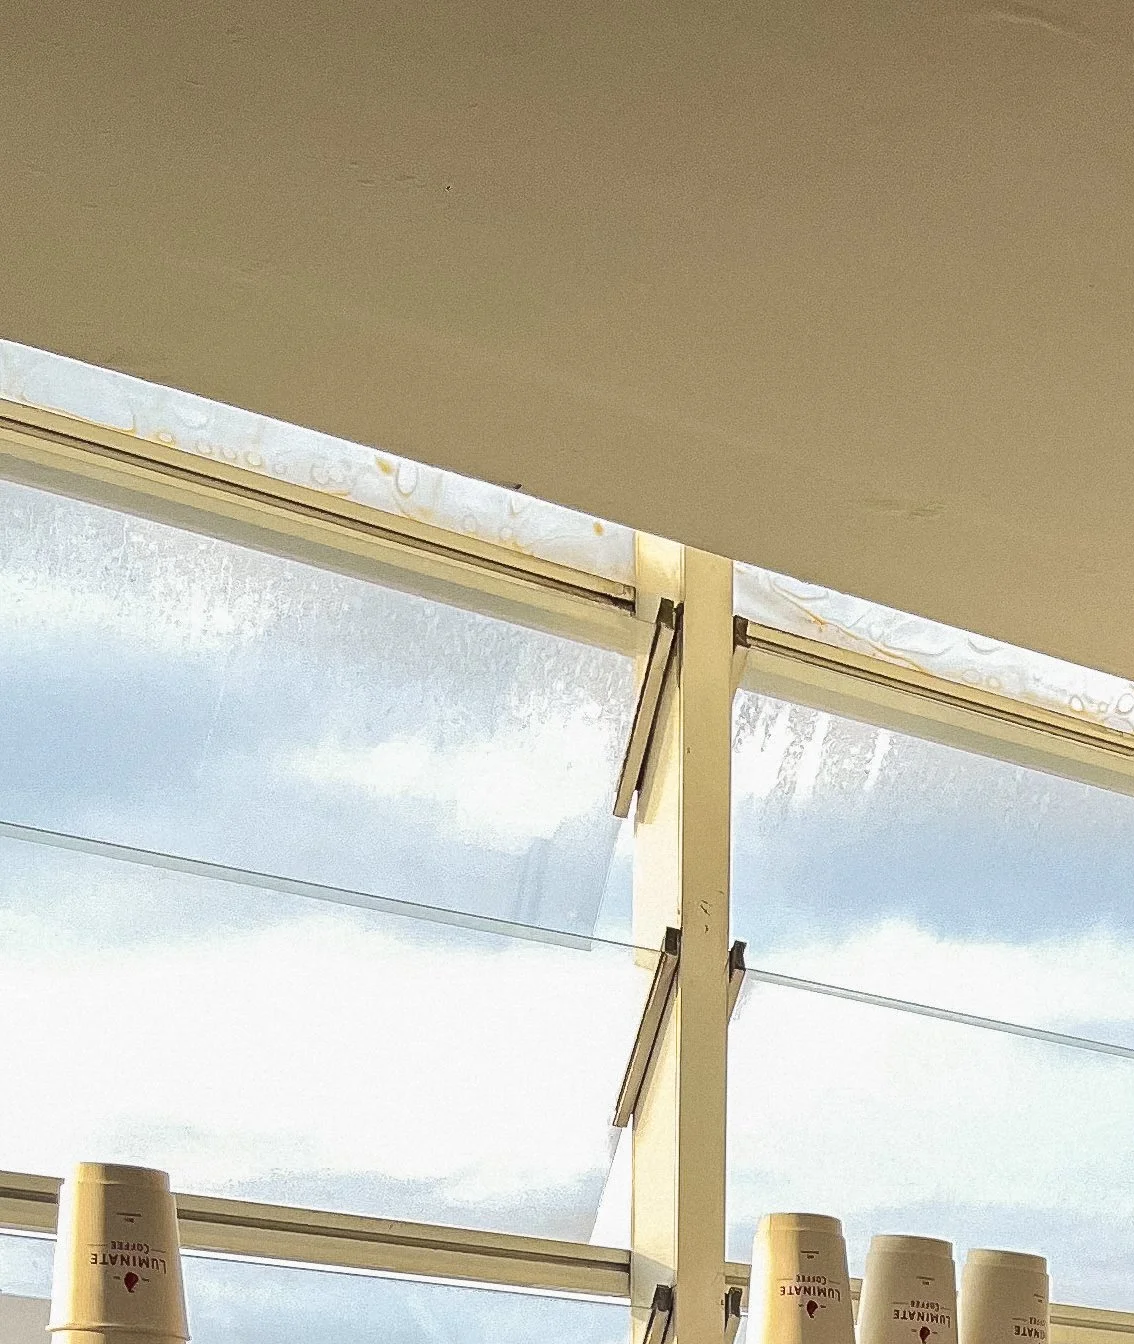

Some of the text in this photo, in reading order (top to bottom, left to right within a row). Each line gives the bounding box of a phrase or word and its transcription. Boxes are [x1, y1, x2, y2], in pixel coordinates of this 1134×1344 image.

[111, 1241, 150, 1255] COFFEE
[90, 1253, 166, 1274] LUMINATE
[779, 1285, 841, 1302] LUMINATE
[893, 1309, 951, 1328] LUMINATE
